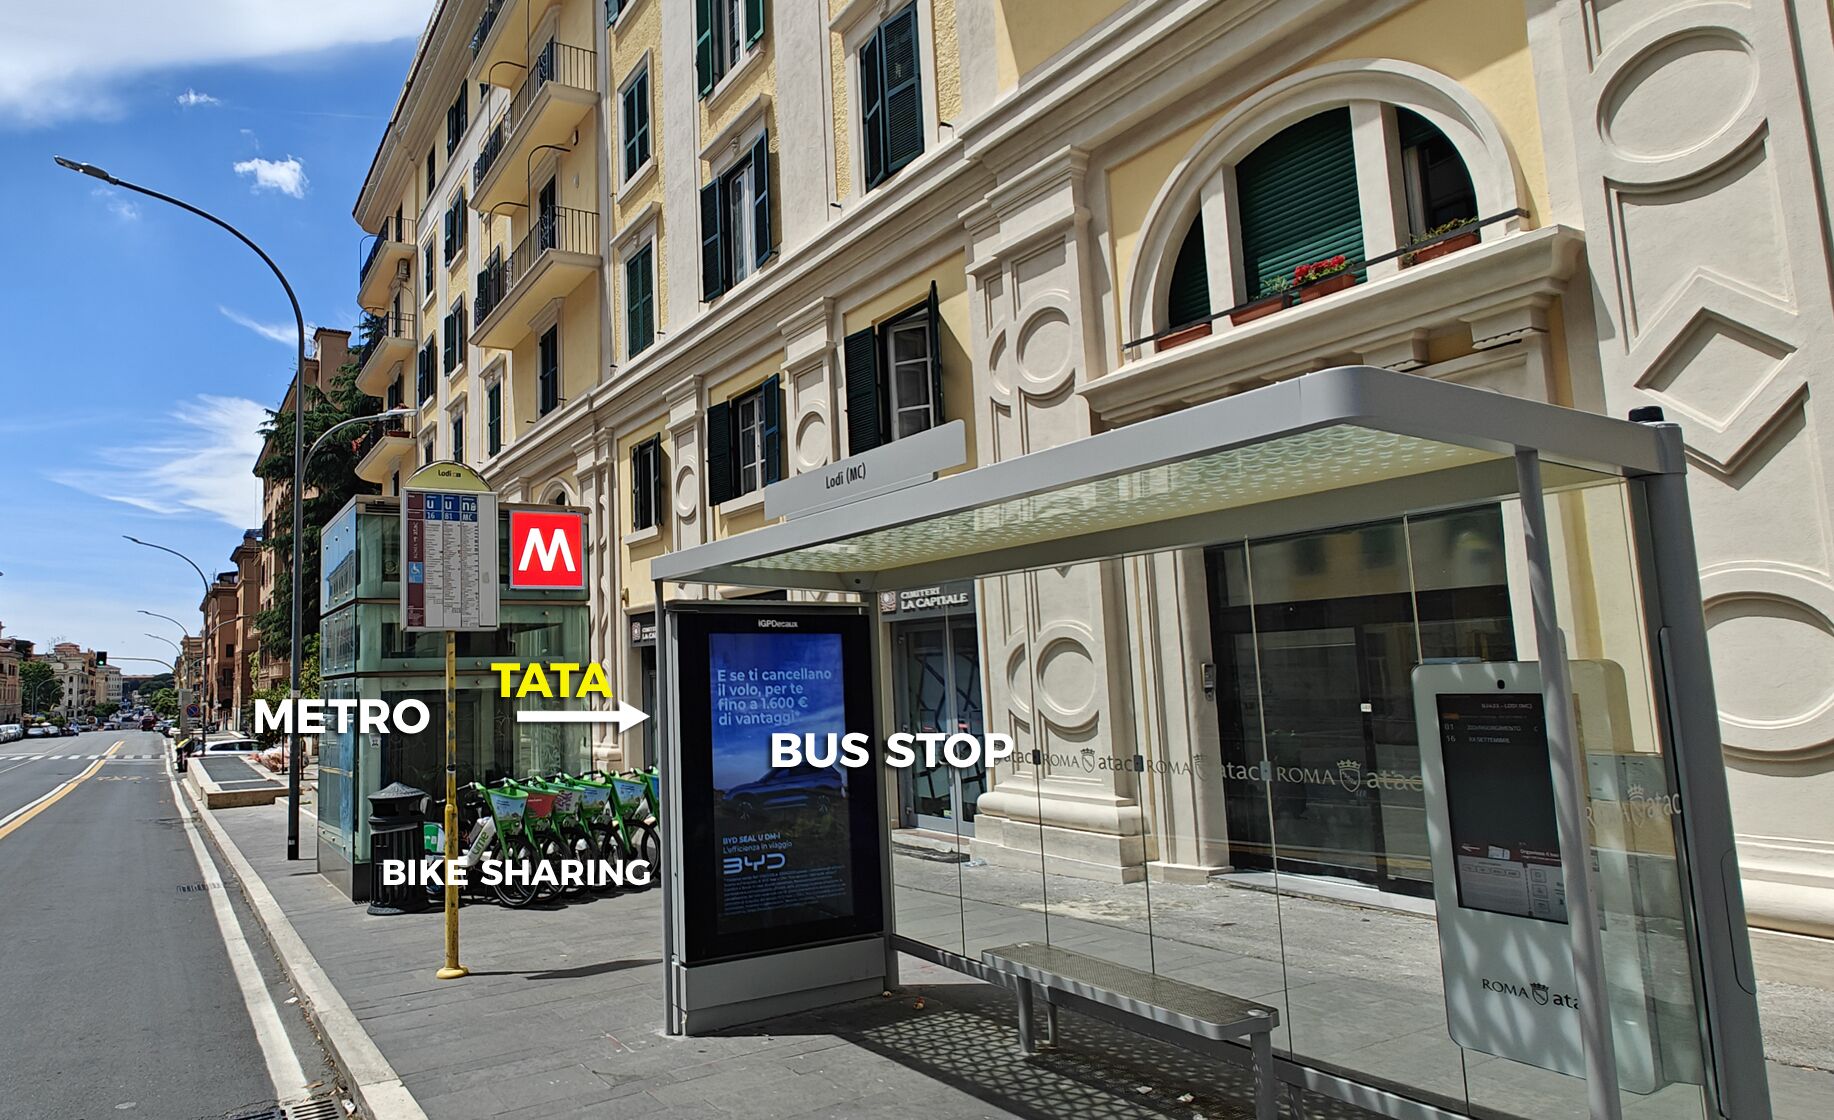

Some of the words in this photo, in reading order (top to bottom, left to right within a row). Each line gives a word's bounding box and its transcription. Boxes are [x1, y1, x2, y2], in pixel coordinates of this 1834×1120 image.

[825, 471, 844, 489] Lodi
[846, 462, 867, 484] (MC)
[518, 527, 577, 572] M
[901, 599, 916, 610] LA
[915, 592, 969, 608] CAPITALE
[717, 669, 727, 682] E
[729, 671, 746, 681] se
[748, 668, 759, 681] ti
[761, 667, 832, 680] cancellano
[717, 683, 726, 697] il
[728, 682, 761, 697] volo,
[764, 683, 788, 698] per
[790, 682, 804, 695] te
[717, 698, 747, 712] fino
[749, 700, 759, 710] a
[760, 696, 795, 710] 1.600
[797, 696, 809, 708] €
[718, 712, 732, 726] di
[1042, 753, 1080, 768] ROMA
[1098, 754, 1135, 772] atac
[1147, 759, 1193, 775] ROMA
[1276, 766, 1336, 785] ROMA
[722, 852, 786, 875] BYD
[1482, 978, 1530, 1000] ROMA
